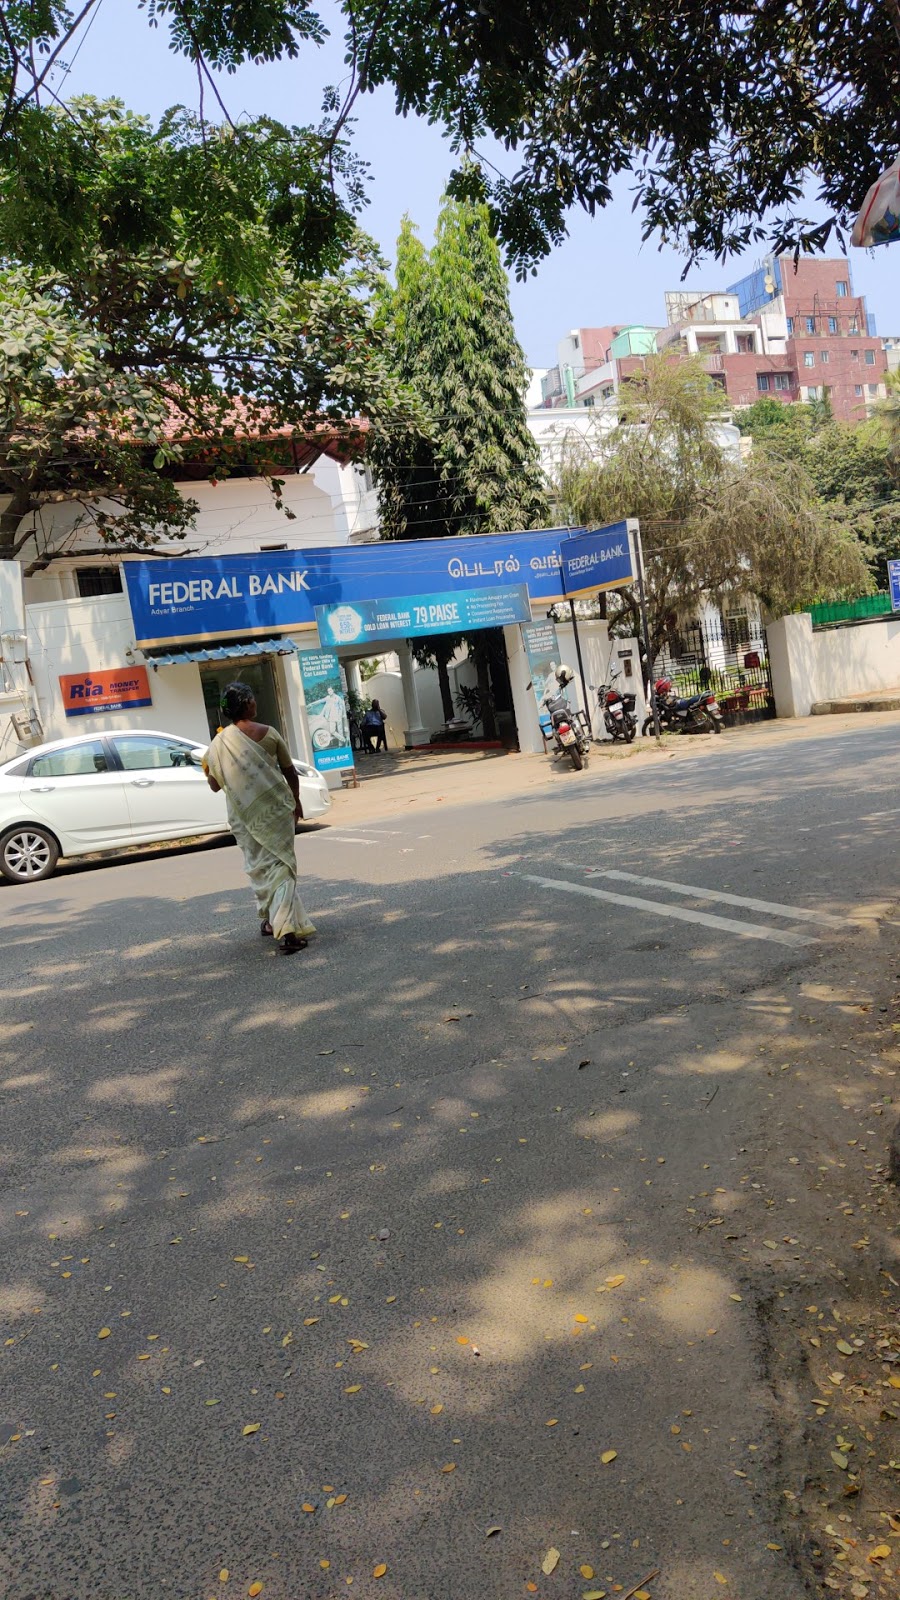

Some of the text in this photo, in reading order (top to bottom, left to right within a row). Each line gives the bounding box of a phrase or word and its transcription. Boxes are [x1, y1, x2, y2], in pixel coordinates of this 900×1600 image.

[447, 554, 520, 578] பெடரல்
[568, 544, 624, 572] FEDERAL BANK
[149, 570, 311, 606] FEDERAL BANK
[151, 605, 195, 616] Adyar Branch
[376, 611, 411, 622] FEDERAL BANK
[413, 602, 459, 624] 79 PAISE
[70, 678, 140, 699] Ria MONEY
[109, 686, 140, 694] TRANSFER
[318, 753, 350, 765] FEDERAL BANK
